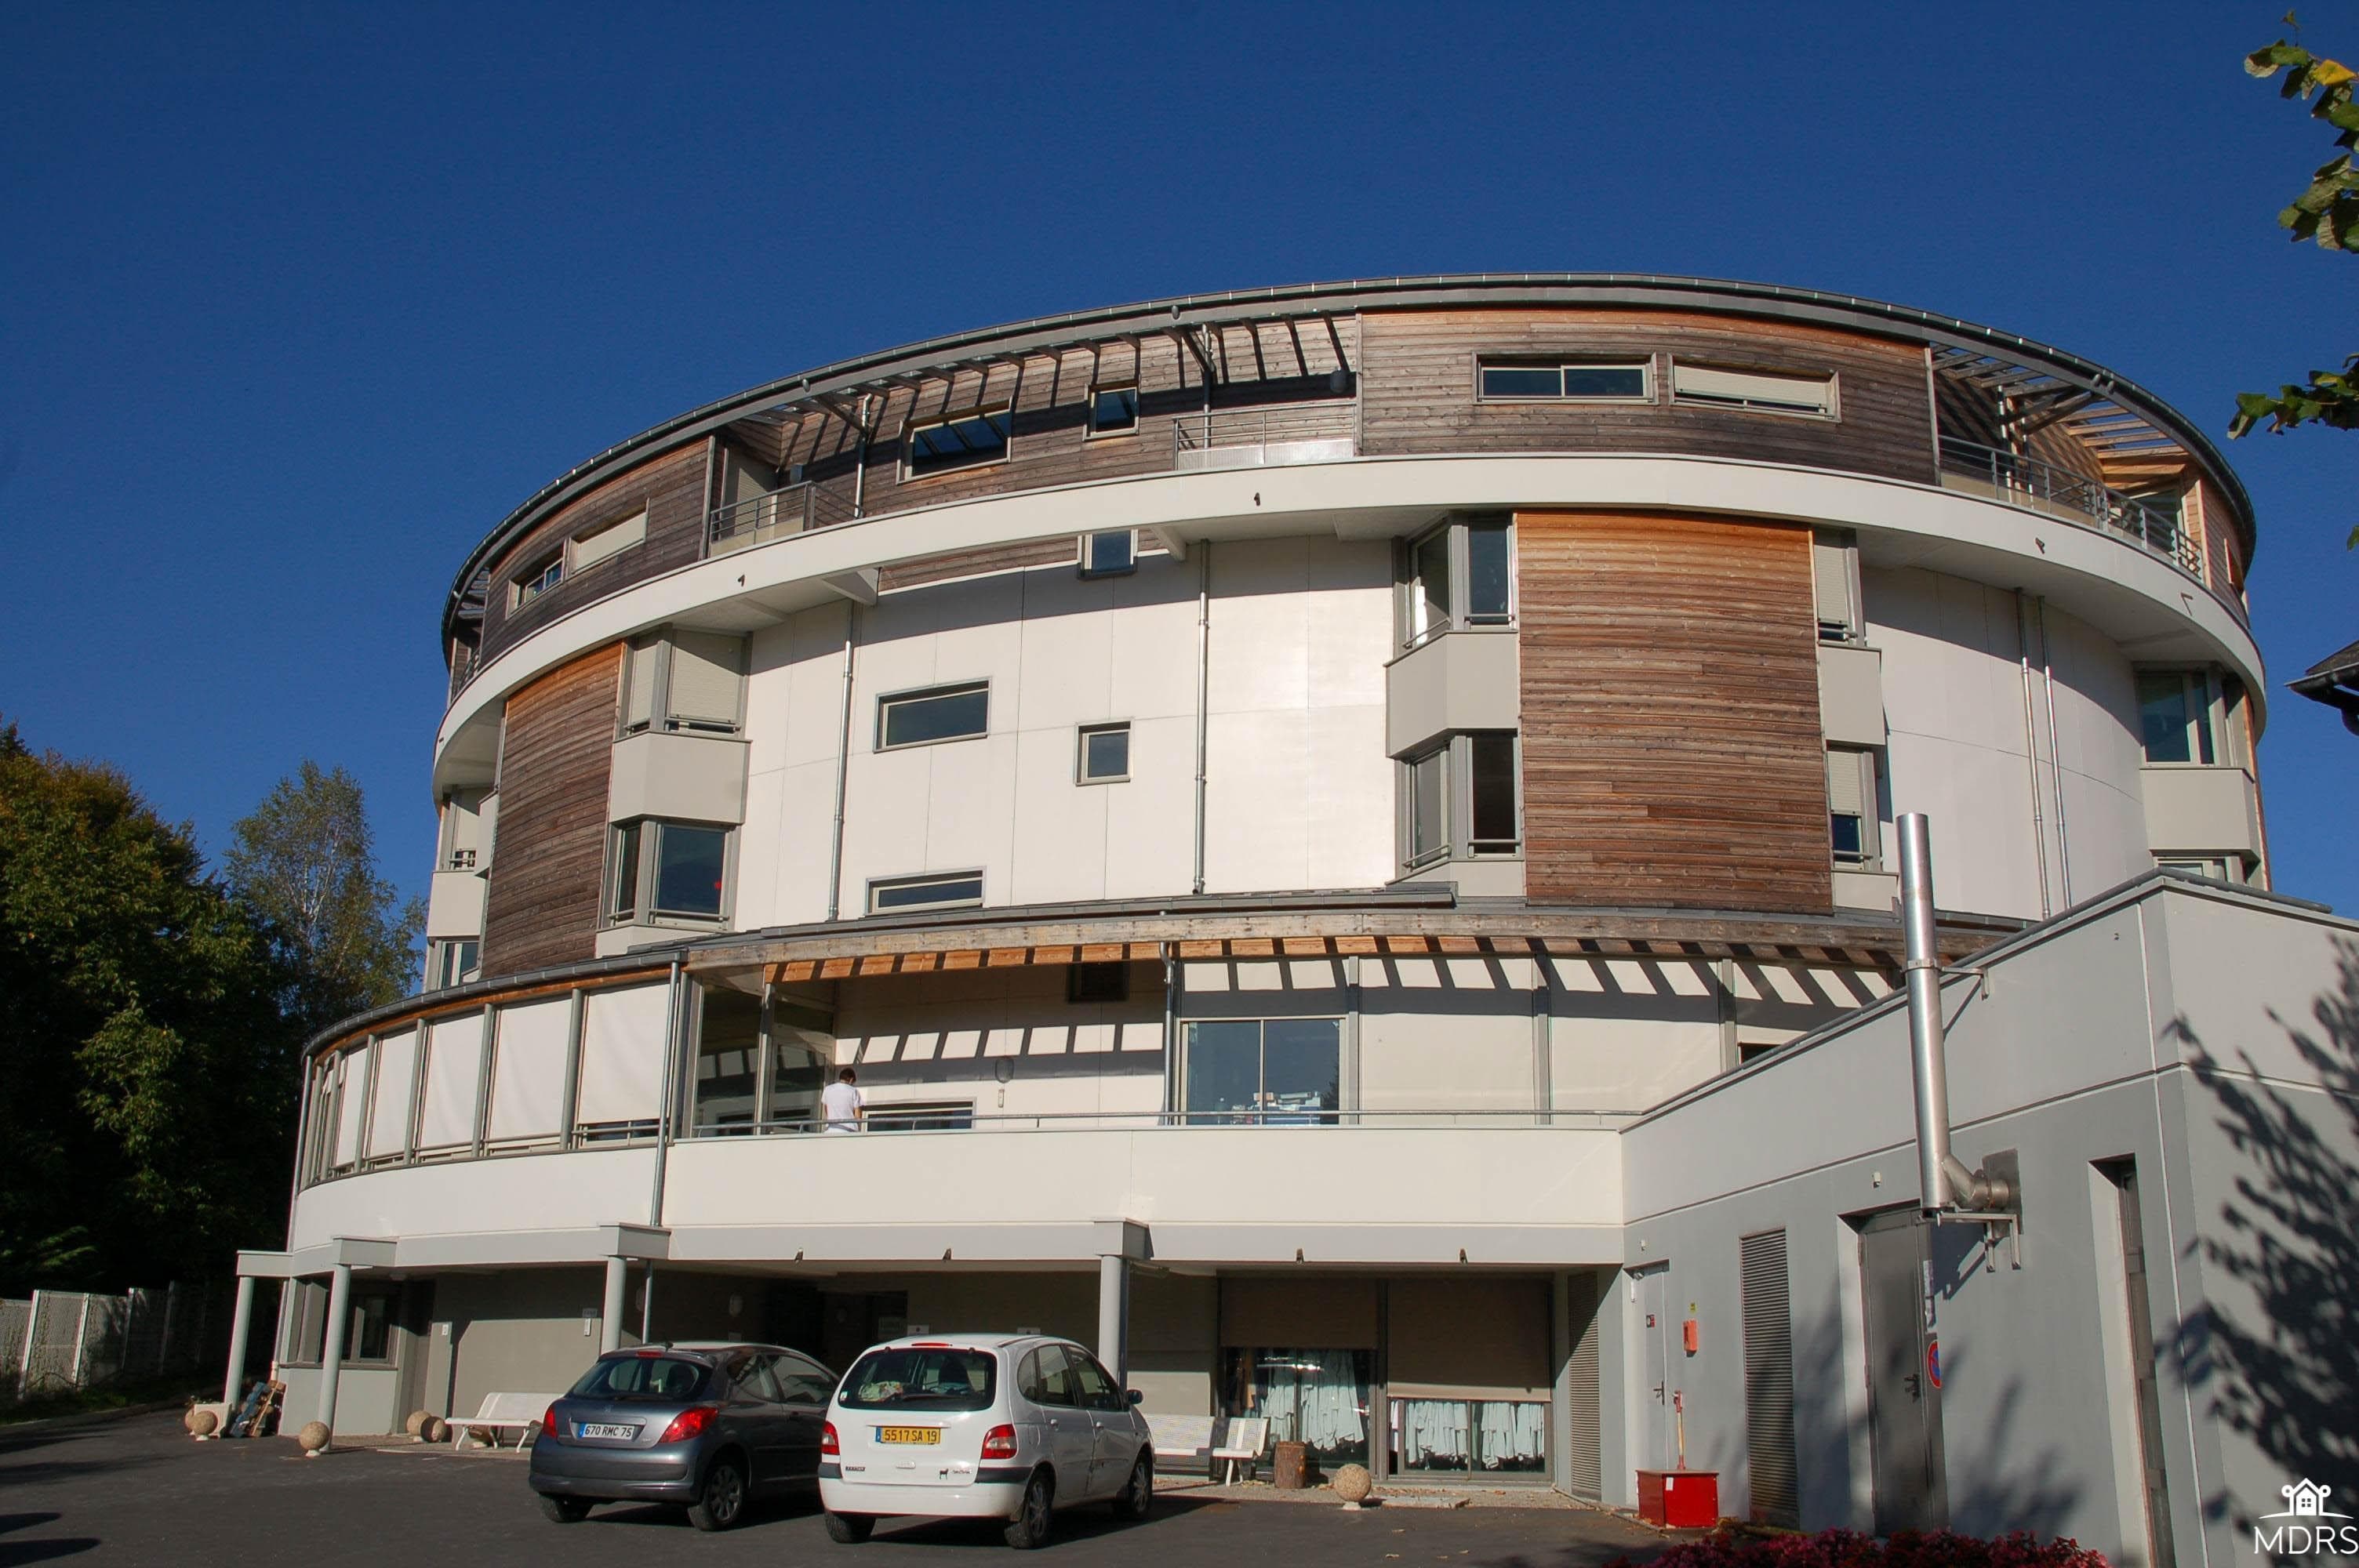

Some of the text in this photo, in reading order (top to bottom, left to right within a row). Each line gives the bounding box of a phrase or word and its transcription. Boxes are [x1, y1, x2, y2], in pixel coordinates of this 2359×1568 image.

[584, 1425, 601, 1436] 670
[621, 1427, 632, 1437] 75
[927, 1430, 937, 1442] 19
